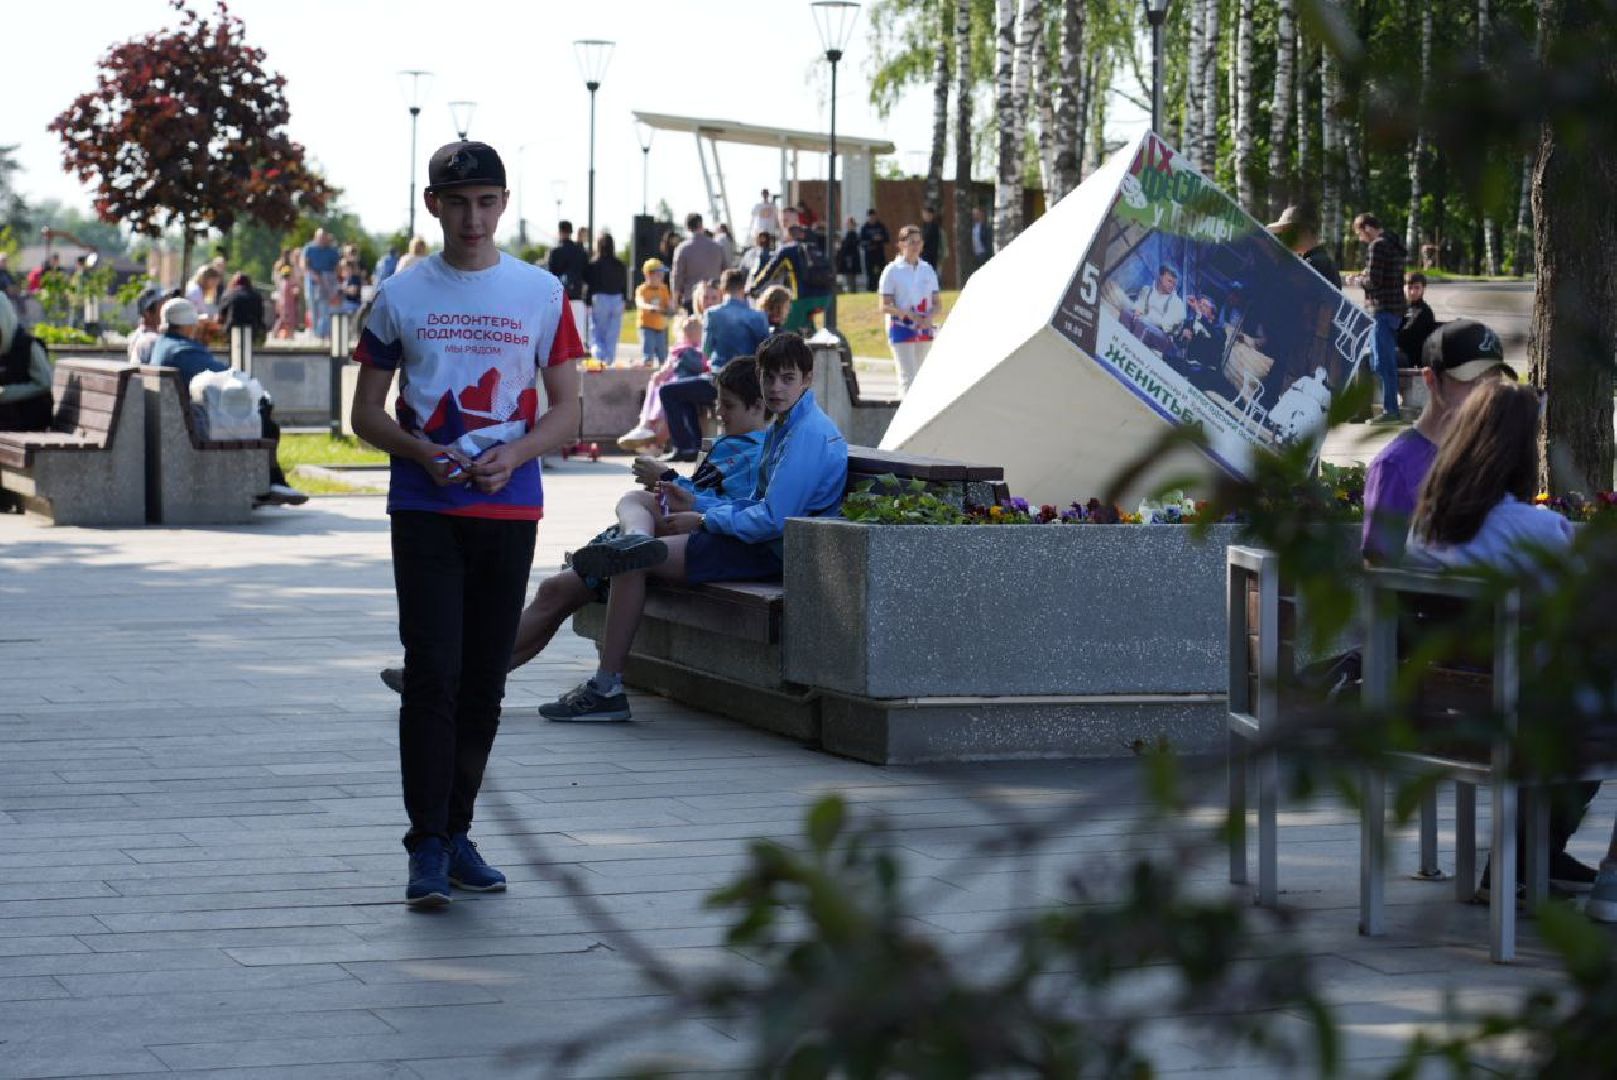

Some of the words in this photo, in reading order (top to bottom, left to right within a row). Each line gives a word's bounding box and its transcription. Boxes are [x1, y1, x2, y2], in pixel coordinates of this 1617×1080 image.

[1080, 261, 1100, 305] 5
[427, 313, 522, 330] ВОЛОНТЕРЫ
[417, 328, 530, 345] ПОДМОСКОВЬЯ
[464, 345, 502, 355] РЯДОМ
